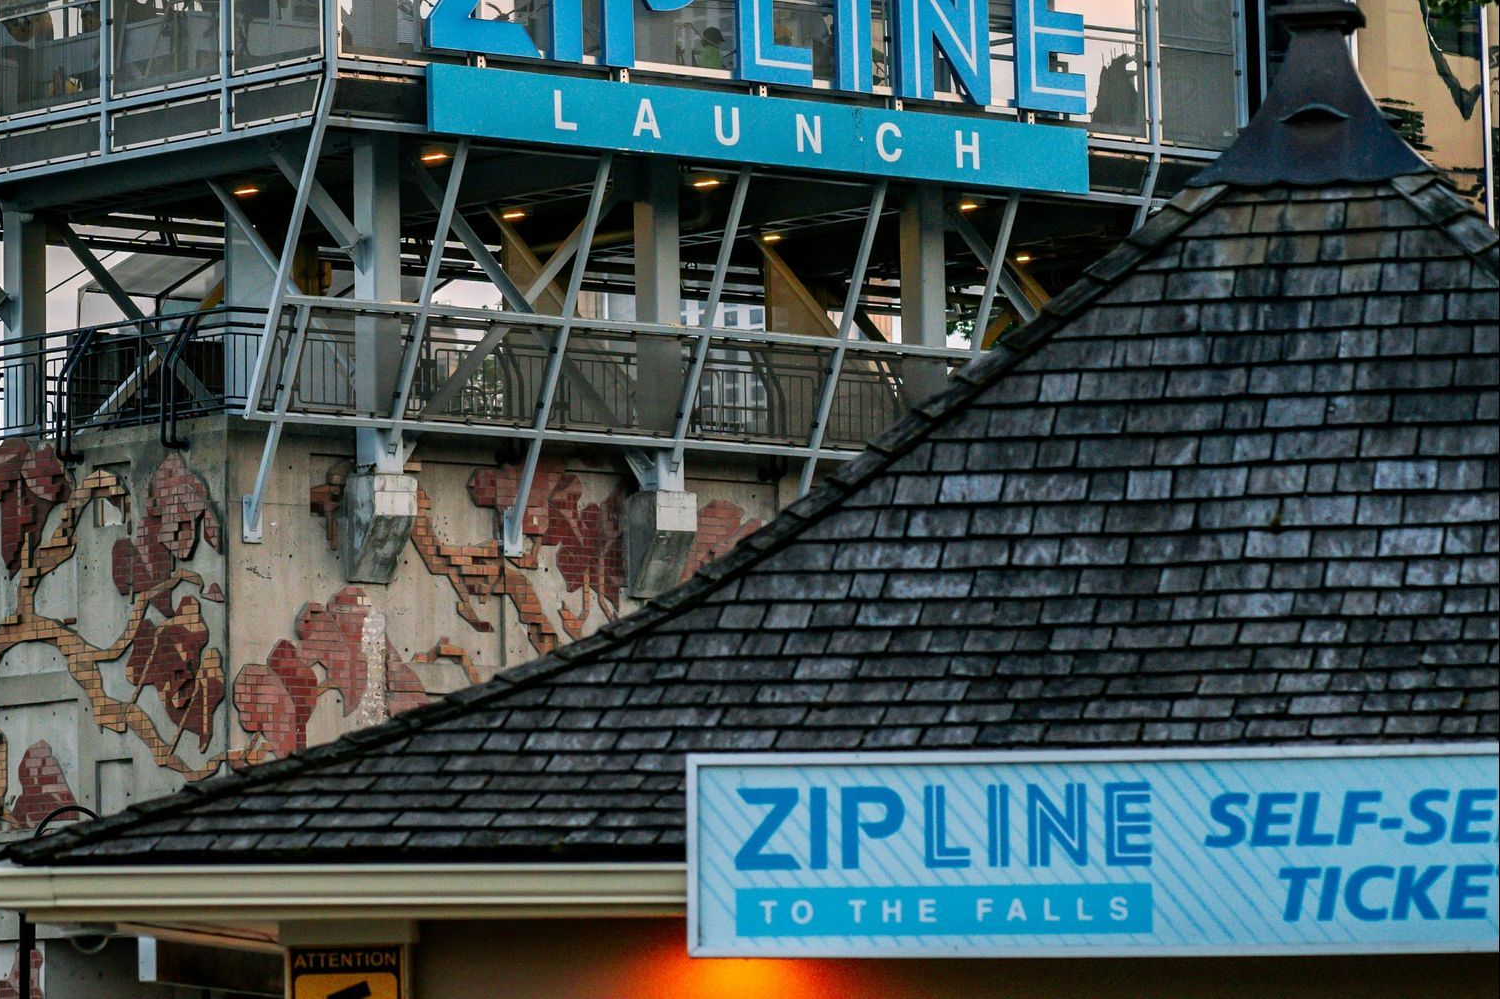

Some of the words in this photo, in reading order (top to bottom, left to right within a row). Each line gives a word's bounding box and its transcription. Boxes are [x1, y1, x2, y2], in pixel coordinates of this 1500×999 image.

[553, 89, 981, 170] LAUNCH
[735, 782, 1153, 870] ZIPLINE
[1204, 788, 1499, 848] SELF-SE
[759, 901, 815, 925] TO
[849, 899, 937, 923] THE
[977, 896, 1130, 922] FALLS
[1278, 864, 1499, 922] TICKE
[295, 952, 396, 968] ATTENTION
